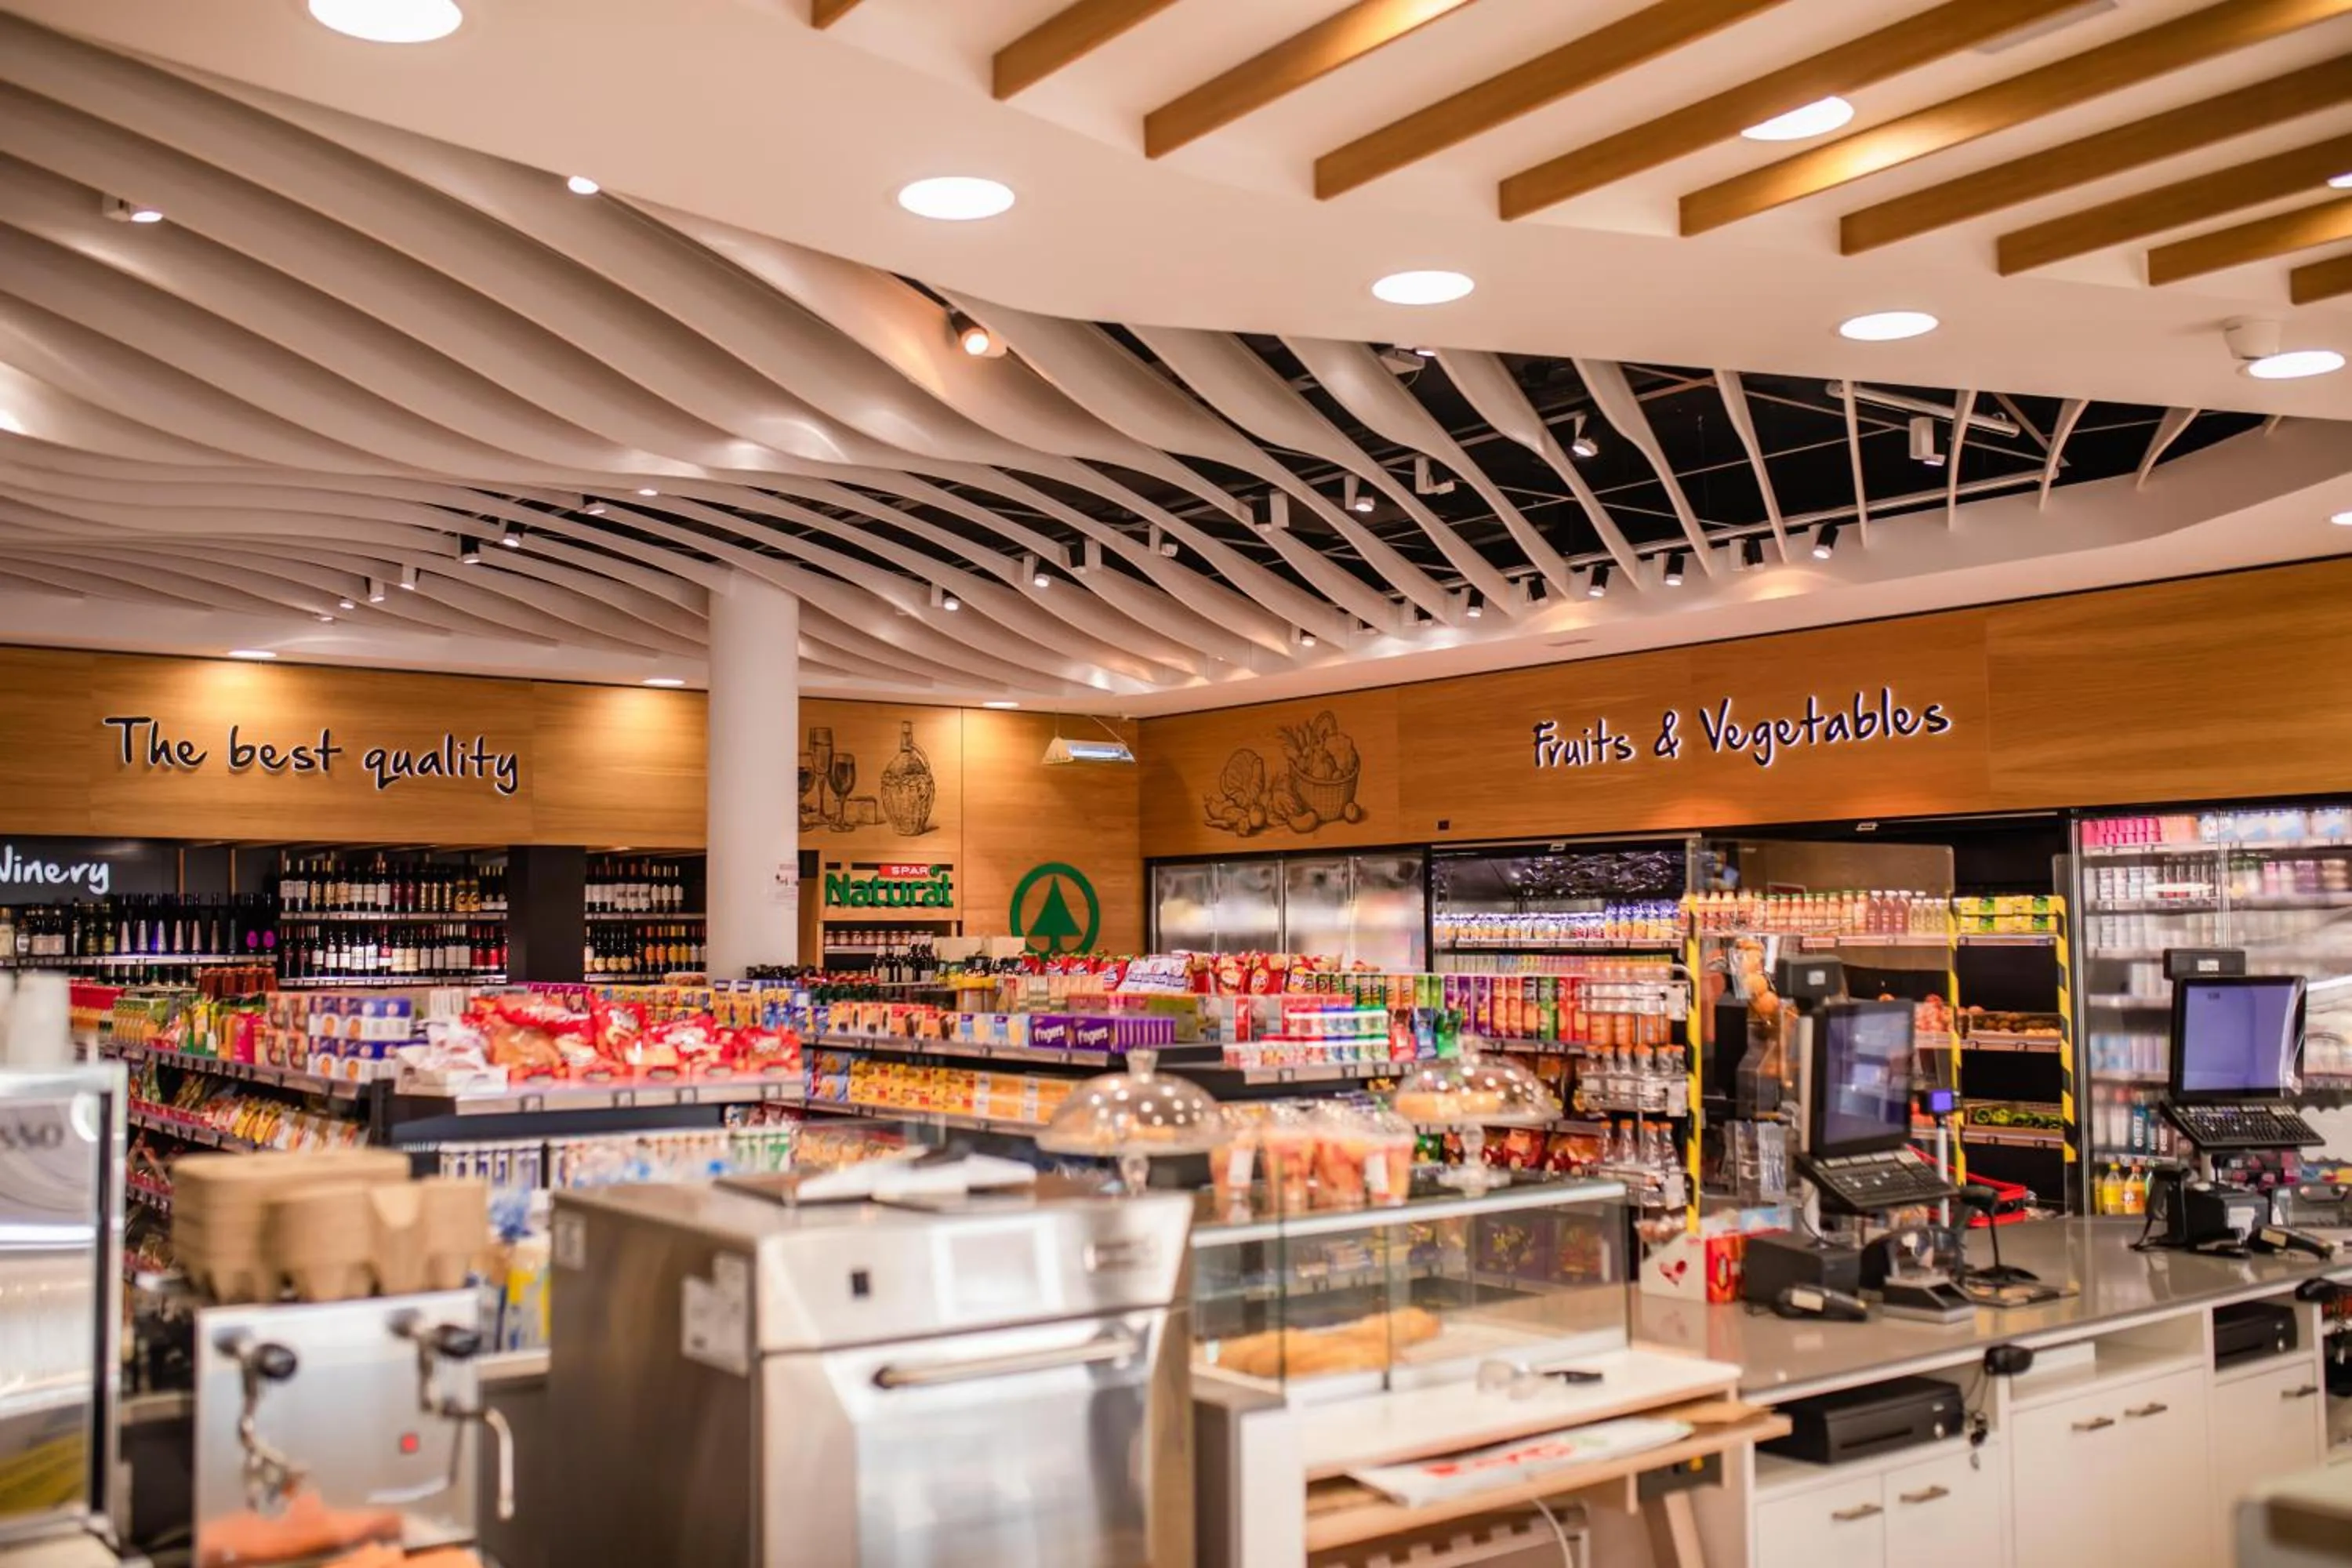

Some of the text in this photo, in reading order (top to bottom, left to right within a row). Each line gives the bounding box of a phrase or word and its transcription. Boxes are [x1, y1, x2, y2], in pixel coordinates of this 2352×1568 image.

[103, 716, 520, 795] The best quality
[1532, 687, 1950, 768] Fruits & Vegetables
[826, 872, 953, 908] Natural
[891, 866, 929, 876] SPAR
